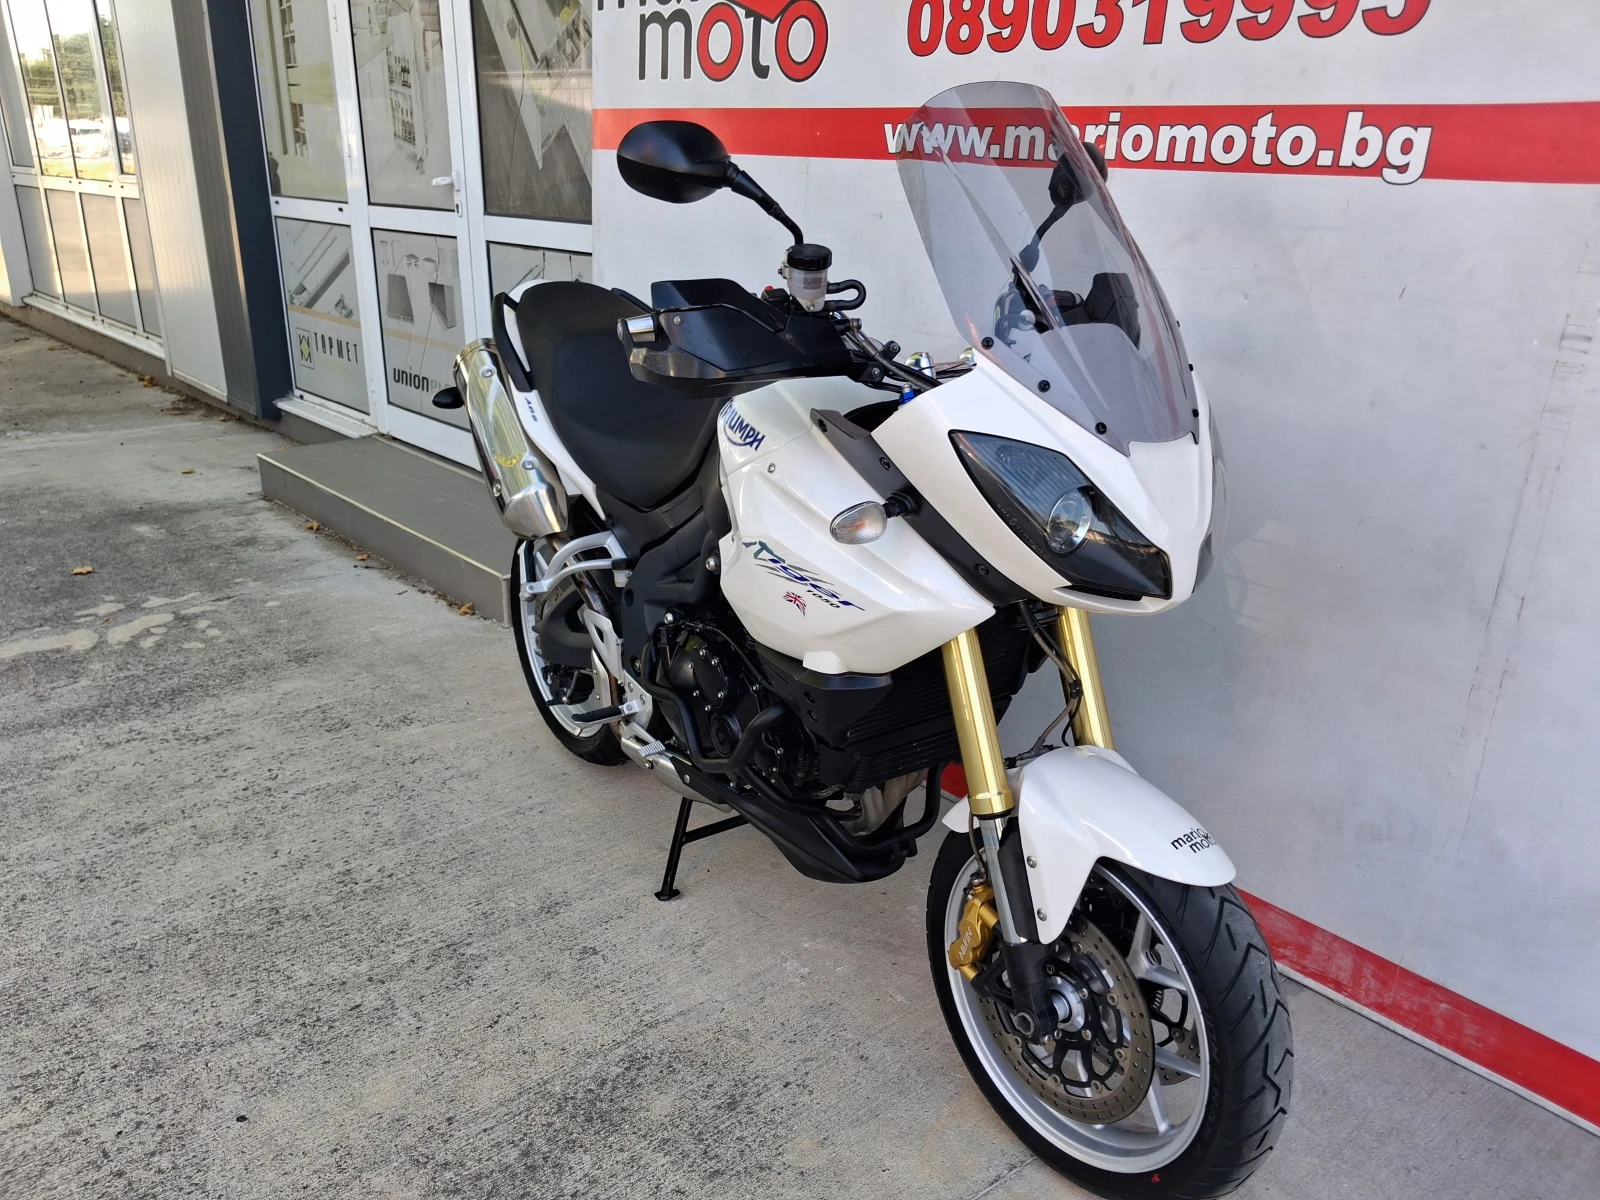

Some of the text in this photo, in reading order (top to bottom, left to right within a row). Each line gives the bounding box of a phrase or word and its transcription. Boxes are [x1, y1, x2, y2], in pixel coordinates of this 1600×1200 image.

[638, 1, 829, 83] moto
[313, 332, 359, 364] TOPMET
[806, 589, 841, 609] 1050
[1170, 827, 1207, 850] mario
